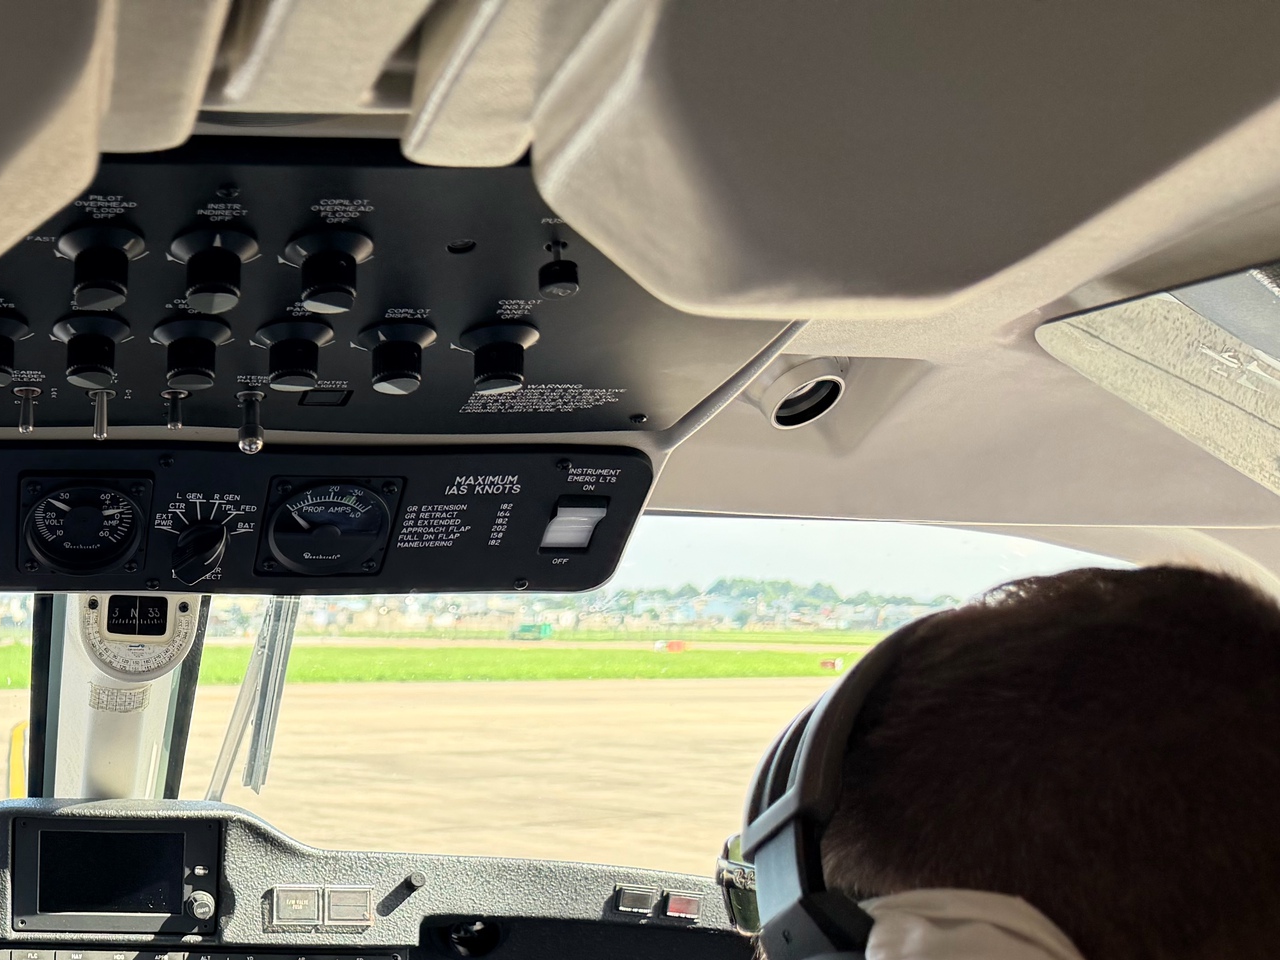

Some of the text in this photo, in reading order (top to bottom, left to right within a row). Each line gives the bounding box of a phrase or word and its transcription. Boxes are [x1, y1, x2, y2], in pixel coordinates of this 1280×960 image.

[568, 468, 622, 476] INSTRUMENT
[455, 475, 519, 485] MAXIMUM
[567, 475, 597, 483] EMERG
[445, 484, 521, 495] IAS KNOTS
[59, 492, 70, 501] 30
[176, 492, 203, 500] L GEN
[214, 493, 241, 501] R GEN
[169, 502, 186, 511] CTR
[221, 504, 257, 512] TPL FED
[302, 506, 352, 515] PROP AMPS
[421, 504, 468, 512] EXTENSION
[44, 518, 64, 526] VOLT
[102, 518, 120, 527] AMP
[154, 519, 173, 527] PWR
[112, 607, 119, 618] 3
[148, 608, 160, 618] 33
